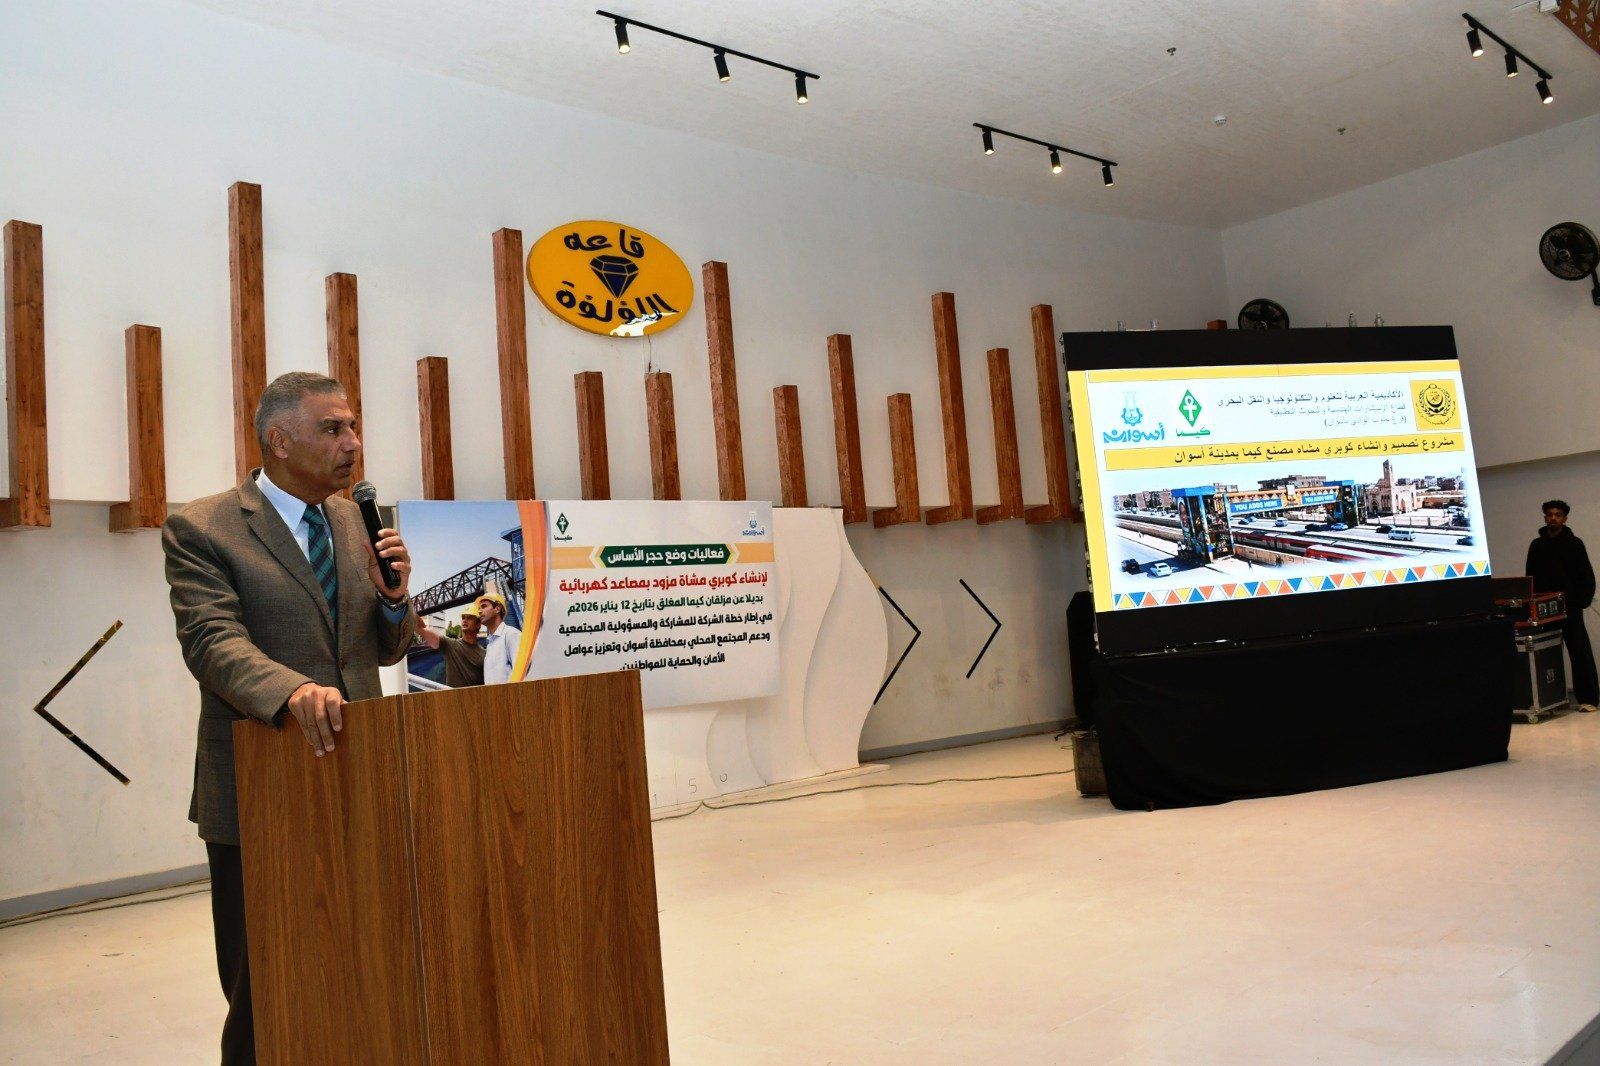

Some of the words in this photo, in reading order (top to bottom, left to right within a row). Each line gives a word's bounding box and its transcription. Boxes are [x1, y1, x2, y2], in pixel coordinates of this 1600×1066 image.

[1103, 422, 1164, 443] أسوان
[1176, 426, 1210, 439] كيما
[1325, 442, 1353, 456] كوبري
[1391, 438, 1418, 451] تصميم
[1422, 437, 1454, 451] مشروع
[1209, 447, 1239, 460] بمدينة
[1242, 446, 1262, 459] كيما
[1266, 446, 1293, 459] مصنع
[1234, 503, 1248, 511] YOU
[607, 547, 644, 564] الأساس
[645, 551, 663, 563] حجر
[665, 549, 687, 564] وضع
[688, 548, 724, 561] فعاليات
[559, 576, 608, 594] كهربائية
[610, 577, 650, 590] بمصاعد
[653, 576, 677, 590] مزود
[680, 573, 706, 586] مشاة
[709, 572, 737, 589] كوبري
[739, 571, 768, 586] لإنشاء
[621, 600, 630, 609] 12
[632, 599, 655, 612] بتاريخ
[656, 597, 686, 610] المغلق
[687, 596, 704, 608] كيما
[706, 595, 731, 606] مزلقان
[733, 596, 744, 604] عن
[567, 602, 598, 616] 2026م
[600, 601, 618, 613] يناير
[659, 616, 696, 629] للمشاركة
[698, 614, 724, 626] الشركة
[725, 613, 743, 623] خطة
[744, 612, 758, 624] إطار
[759, 612, 773, 624] في
[559, 622, 605, 636] المجتمعية
[607, 618, 658, 633] والمسؤولية
[649, 637, 686, 649] بمحافظة
[687, 634, 715, 649] المحلي
[717, 632, 747, 646] المجتمع
[749, 632, 770, 643] ودعم
[564, 644, 593, 657] عوامل
[595, 642, 621, 655] وتعزيز
[622, 637, 648, 652] أسوان
[667, 656, 701, 669] والحماية
[703, 652, 725, 665] الأمان
